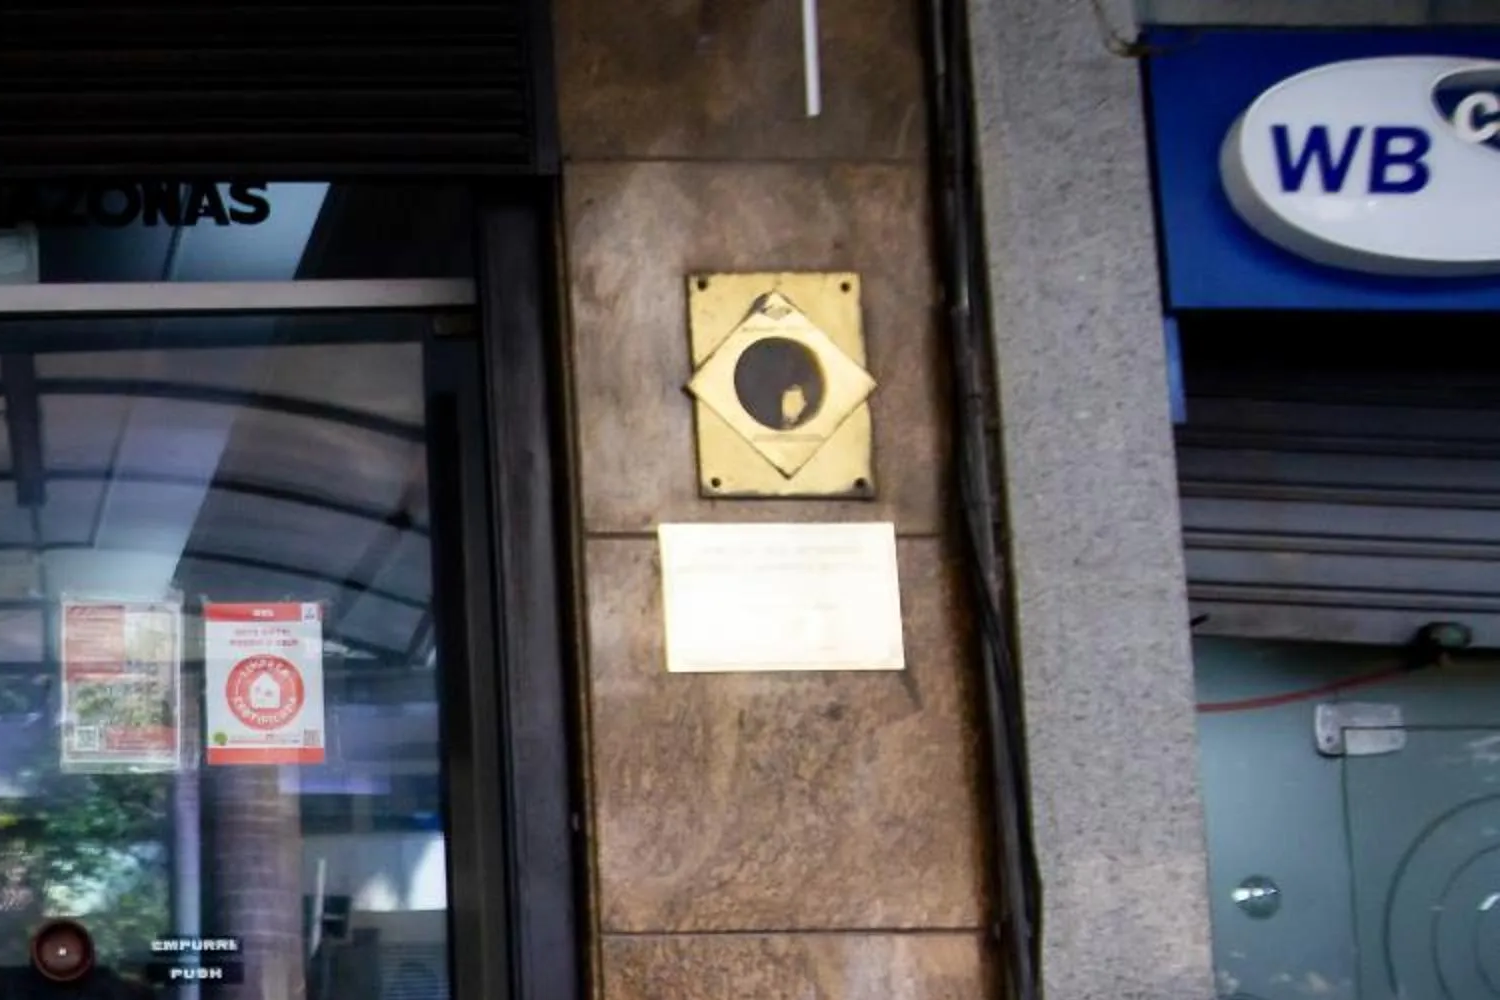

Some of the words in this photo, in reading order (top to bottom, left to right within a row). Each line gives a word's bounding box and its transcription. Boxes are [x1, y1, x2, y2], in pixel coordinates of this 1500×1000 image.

[1270, 124, 1432, 195] WB
[150, 938, 238, 951] EMPURRE
[170, 966, 223, 979] PUSH
